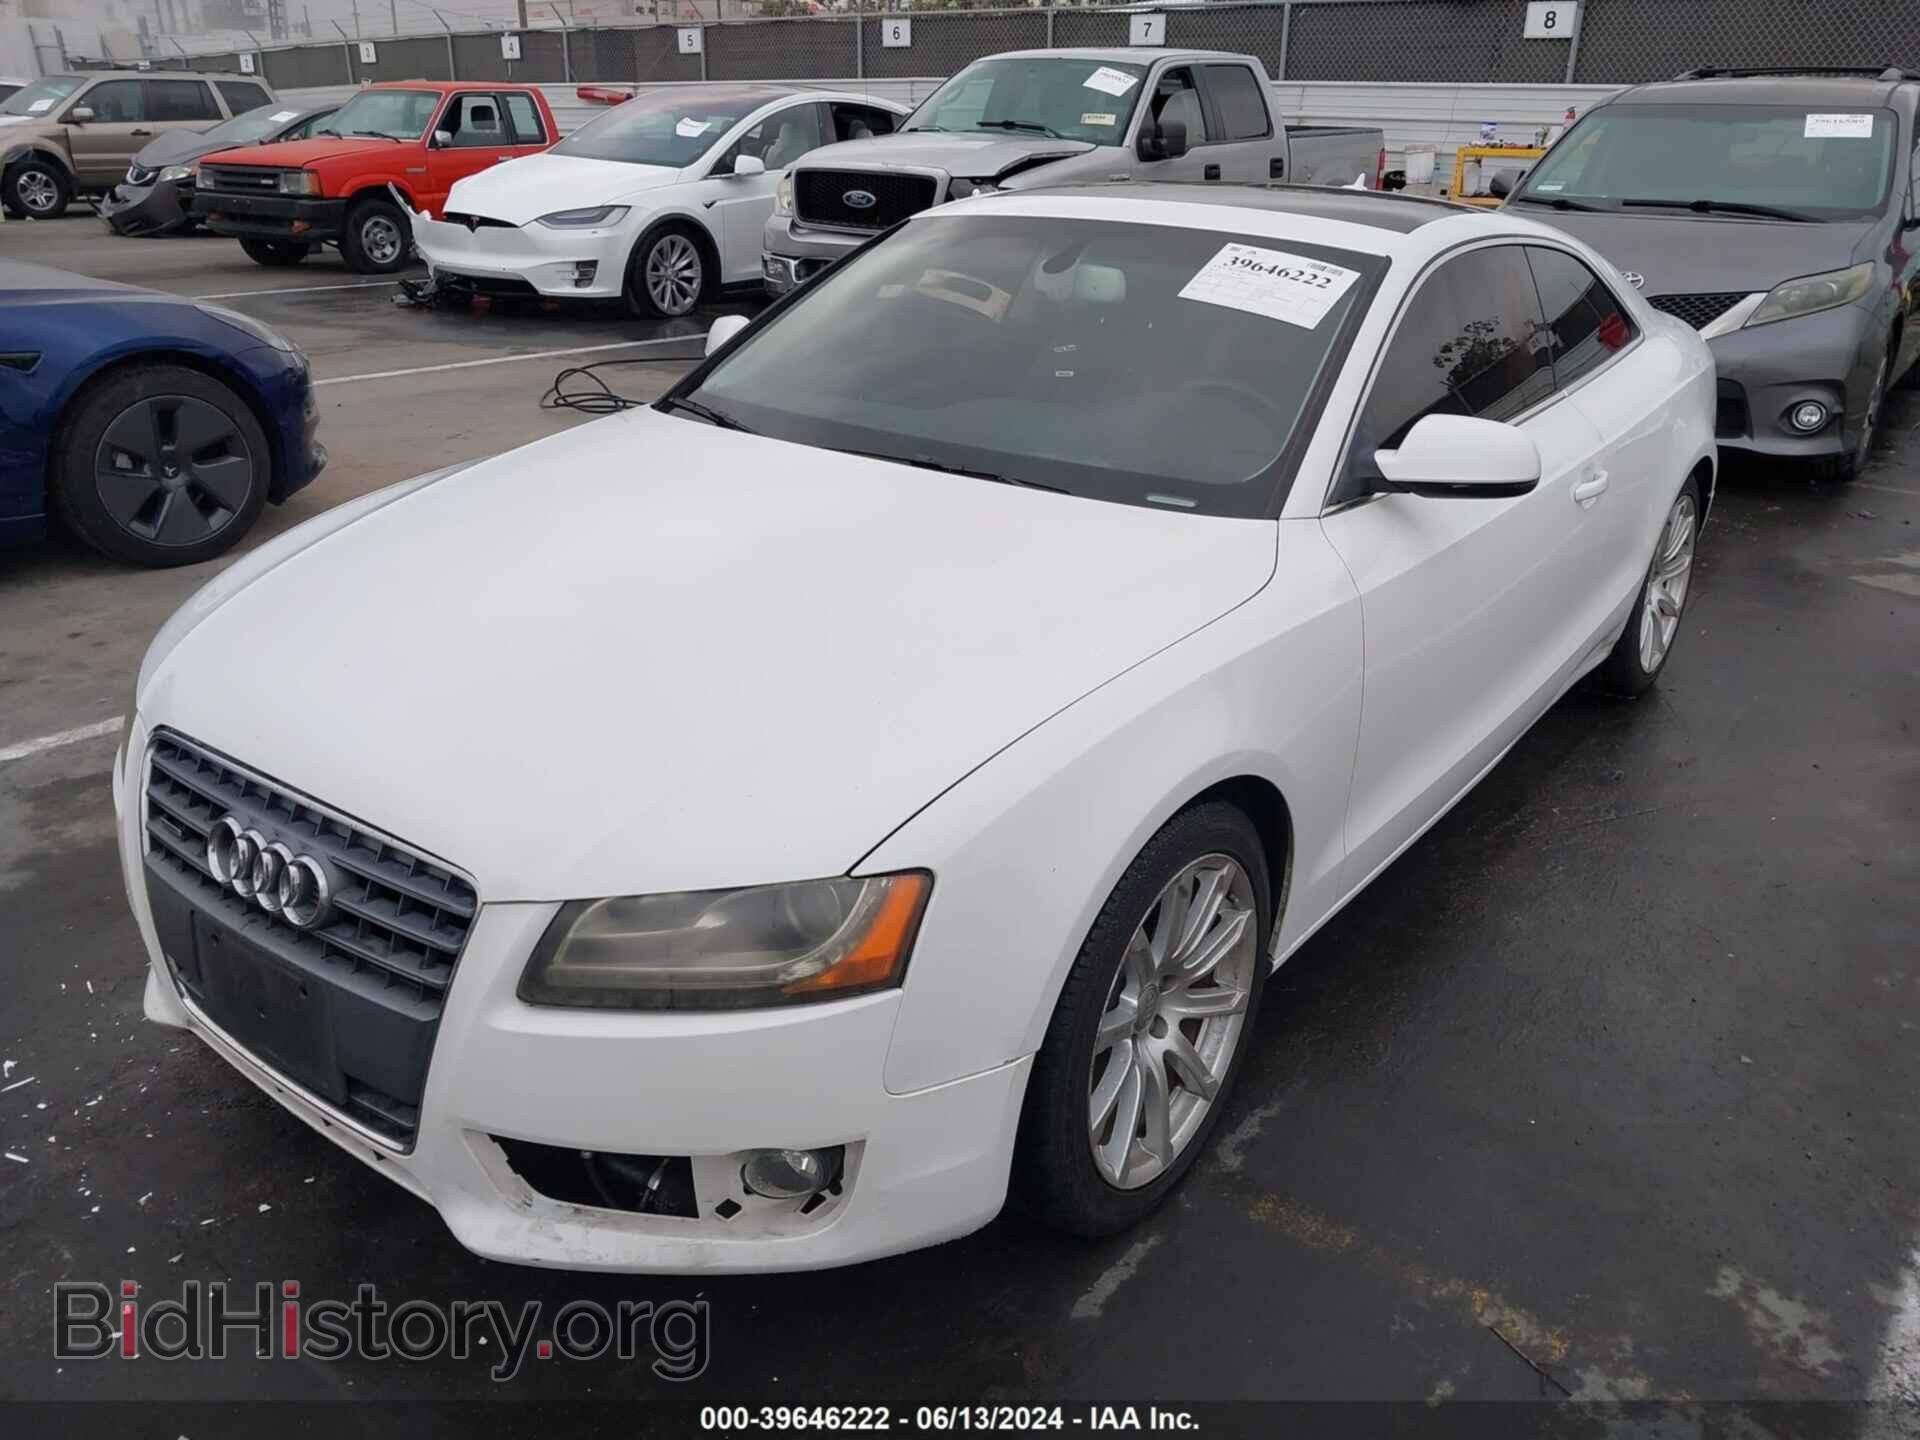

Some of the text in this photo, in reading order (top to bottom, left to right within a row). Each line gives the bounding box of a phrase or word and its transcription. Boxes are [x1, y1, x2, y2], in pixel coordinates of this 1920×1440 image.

[1543, 11, 1556, 29] 8
[892, 26, 901, 40] 6
[1143, 22, 1153, 38] 7
[509, 42, 515, 53] 4
[687, 35, 694, 47] 5
[1223, 255, 1333, 289] 39646222
